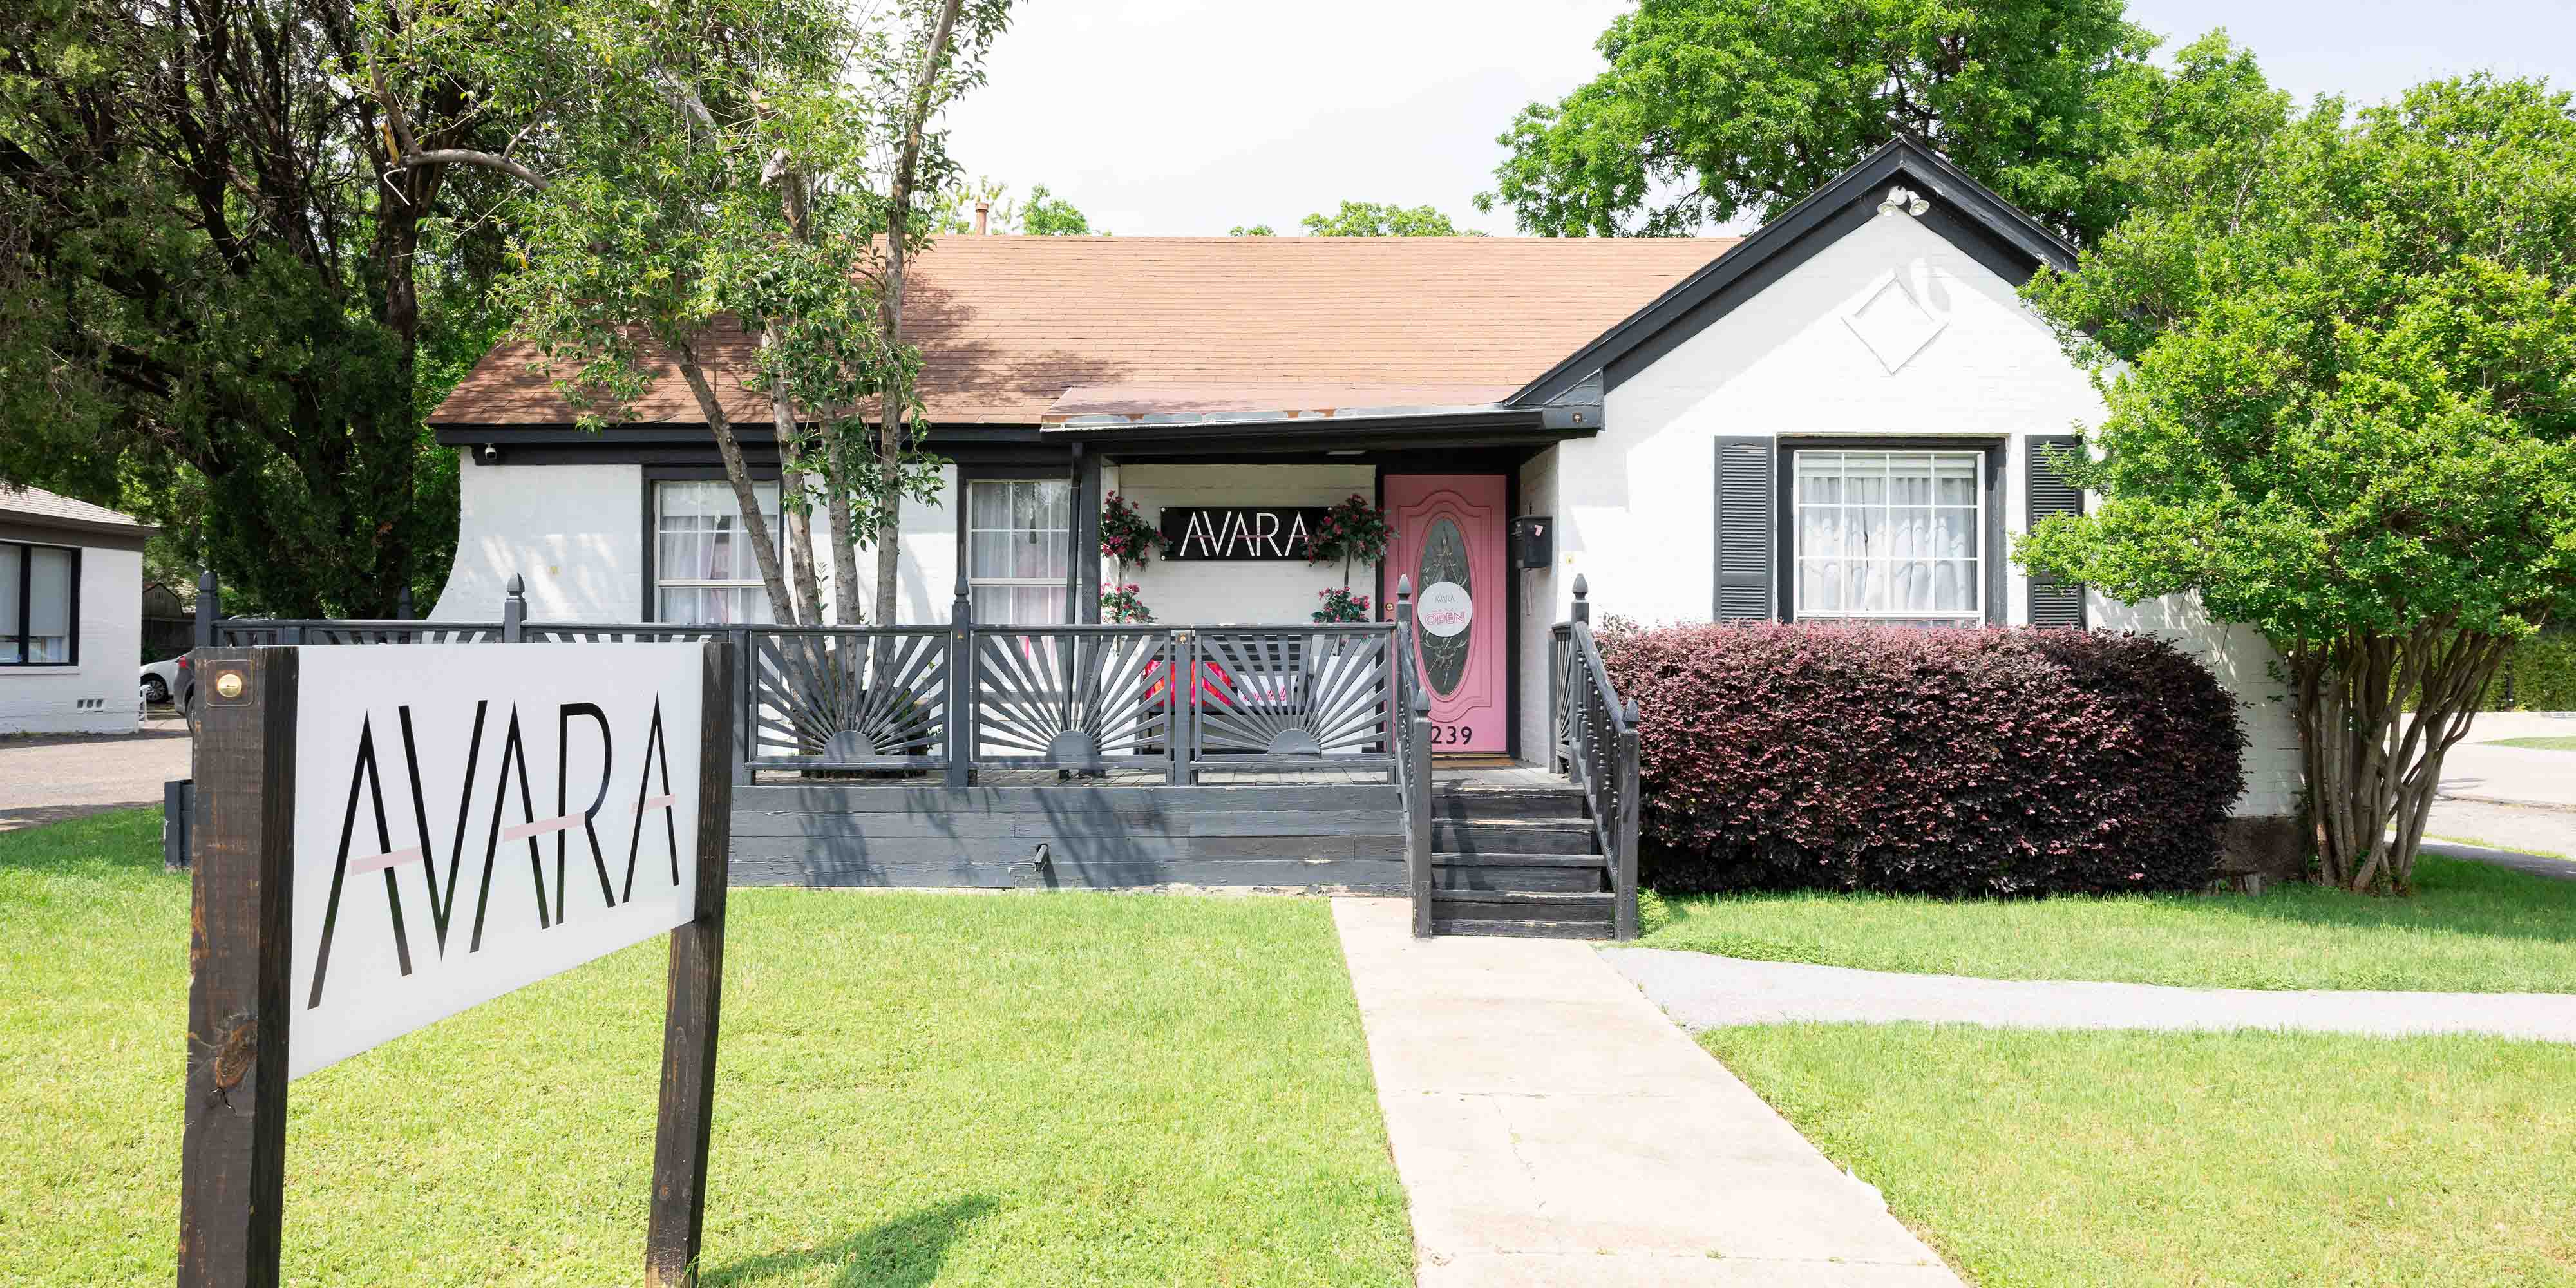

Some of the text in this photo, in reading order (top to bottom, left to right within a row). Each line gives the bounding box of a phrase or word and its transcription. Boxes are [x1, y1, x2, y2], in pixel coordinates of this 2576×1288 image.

[1179, 511, 1309, 556] AVARA
[1425, 612, 1465, 625] OPEN
[1431, 725, 1472, 745] 239
[307, 690, 680, 1010] AVARA
